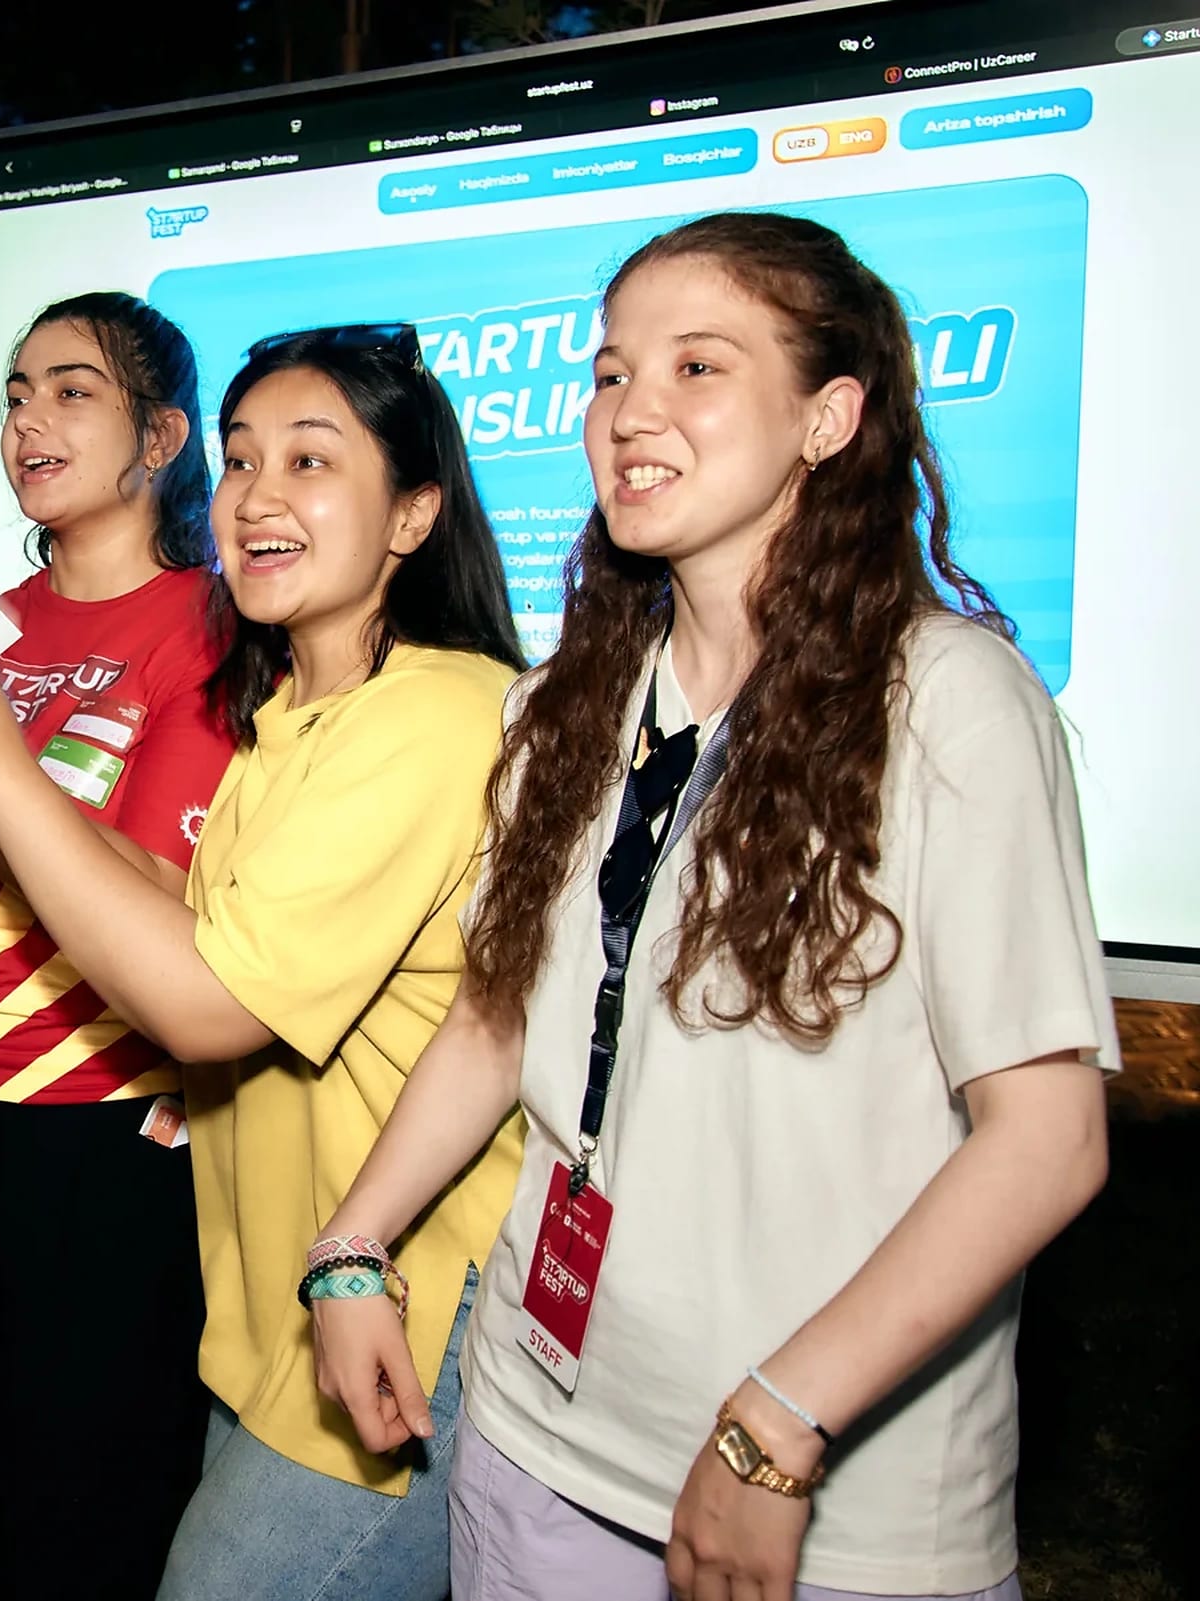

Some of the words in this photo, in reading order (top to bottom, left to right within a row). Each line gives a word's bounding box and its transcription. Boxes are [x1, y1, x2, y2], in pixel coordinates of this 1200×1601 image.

[904, 58, 972, 79] ConnectPro
[980, 51, 1037, 69] UzCareer
[527, 80, 594, 97] startupfest.uz
[667, 97, 719, 111] Instagram
[924, 119, 970, 134] Ariza
[974, 104, 1066, 128] topshirish
[446, 128, 479, 141] Google
[839, 130, 873, 145] ENG
[231, 158, 261, 171] Google
[664, 146, 743, 167] Bosqichlar
[153, 207, 206, 225] STARTUP
[153, 223, 182, 236] FEST
[913, 324, 997, 388] LI
[539, 1267, 565, 1298] FEST
[543, 1252, 588, 1300] STARTUP
[528, 1328, 564, 1368] STAFF
